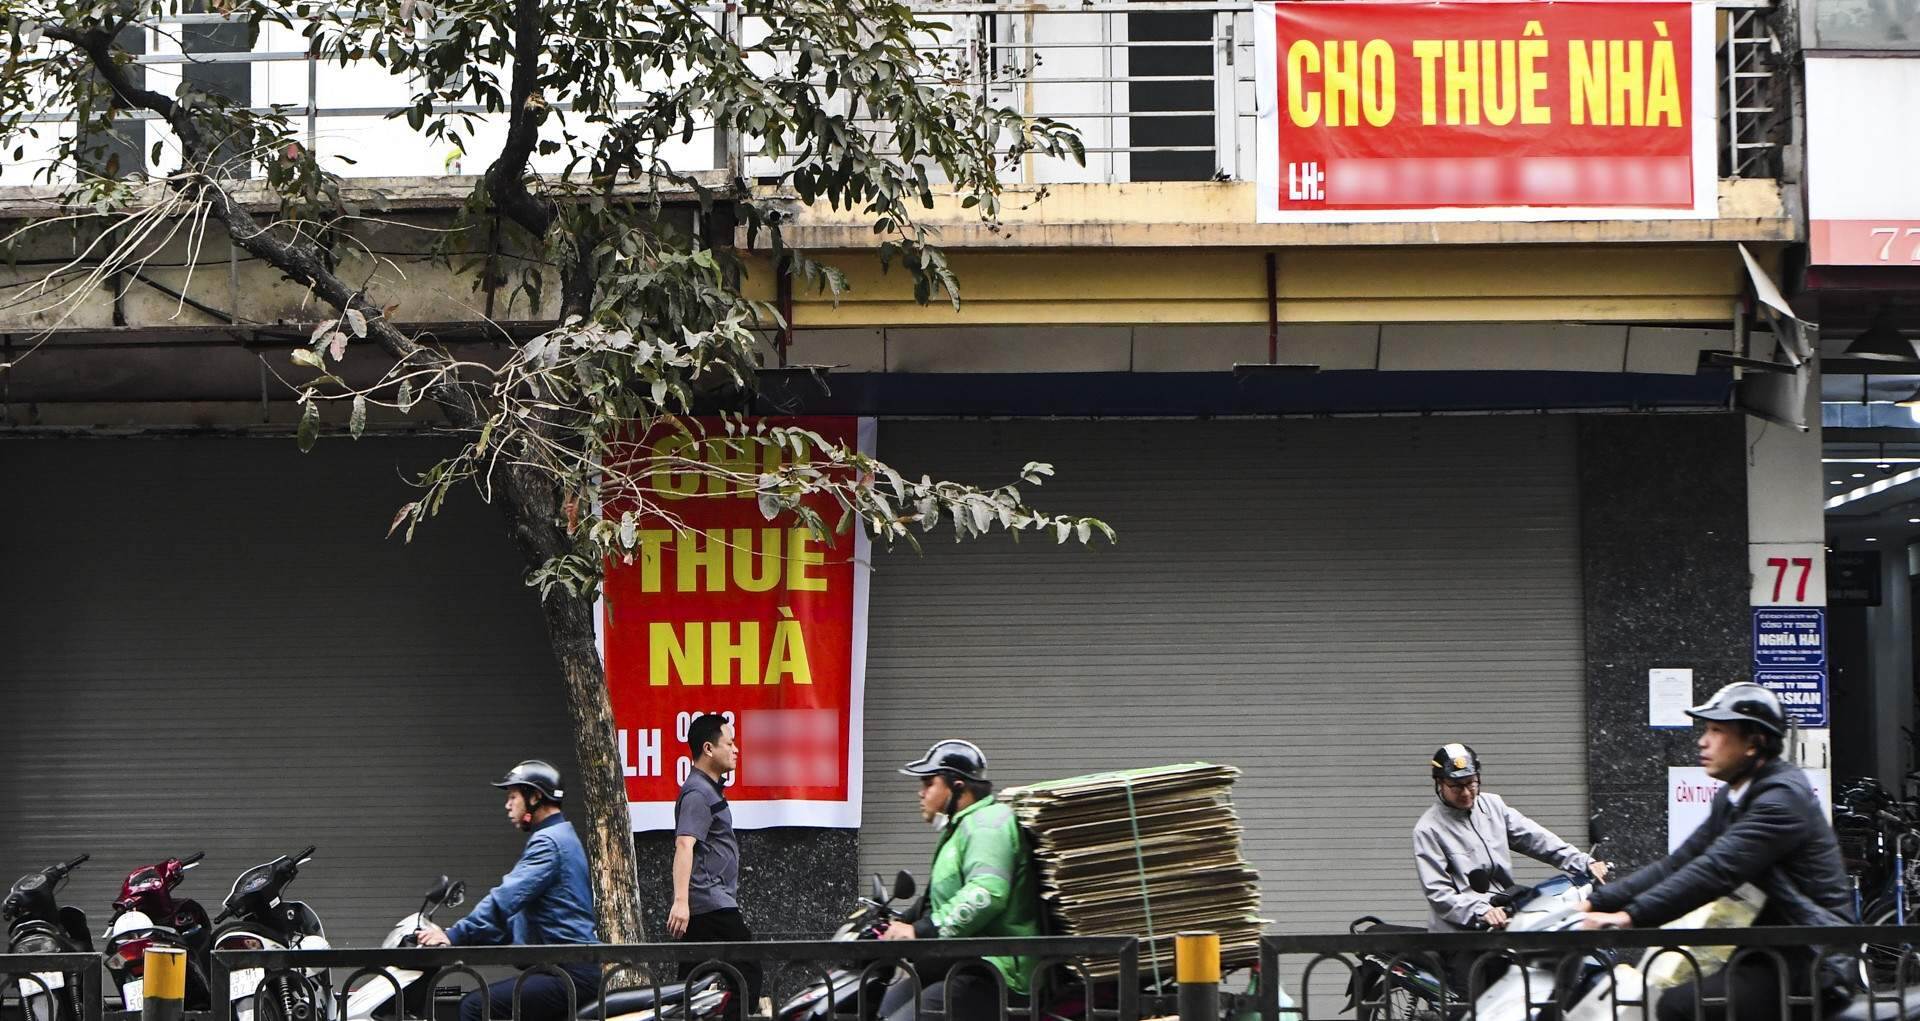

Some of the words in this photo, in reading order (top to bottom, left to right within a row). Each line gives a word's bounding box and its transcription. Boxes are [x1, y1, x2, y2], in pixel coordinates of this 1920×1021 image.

[1287, 39, 1396, 128] CHO
[1413, 20, 1551, 126] THUÊ
[1568, 21, 1683, 127] NHÀ
[1288, 162, 1325, 200] LH:
[1766, 557, 1813, 602] 77
[649, 606, 813, 686] NHÀ
[1759, 631, 1797, 646] NGHĨA
[1799, 629, 1820, 646] HẢI
[618, 728, 662, 777] LH
